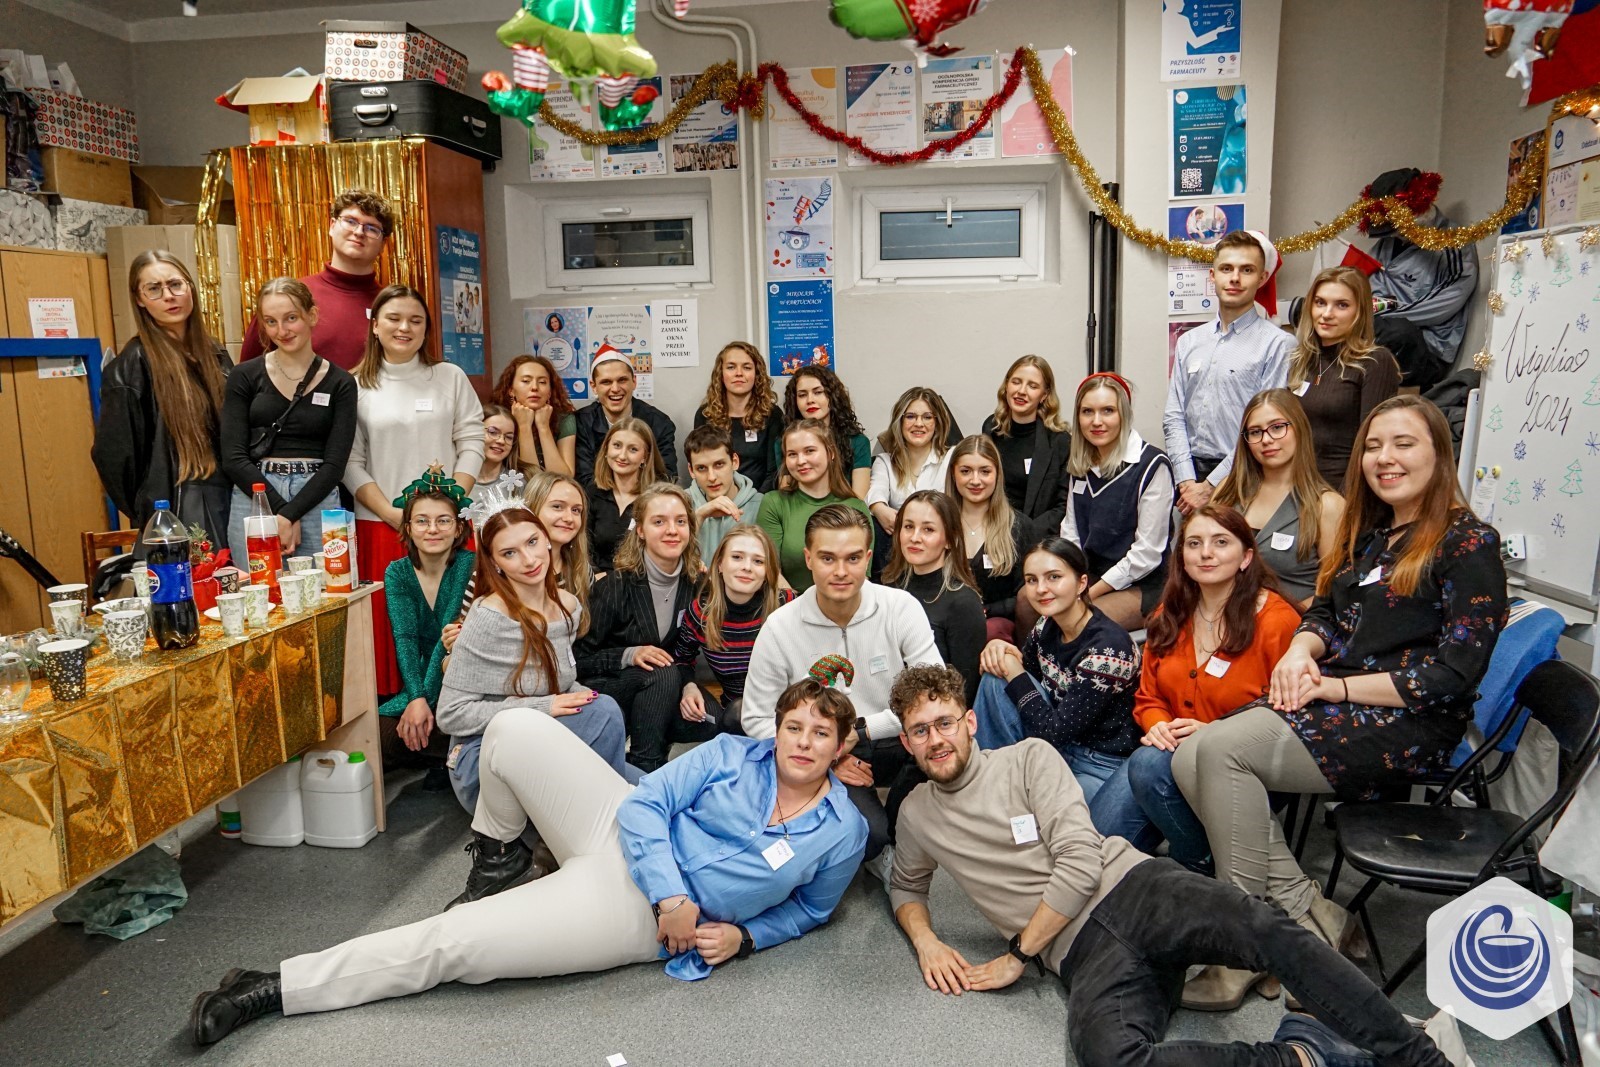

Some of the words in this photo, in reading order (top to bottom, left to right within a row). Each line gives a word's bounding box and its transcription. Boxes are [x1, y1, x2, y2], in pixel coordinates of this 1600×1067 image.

[1170, 58, 1206, 66] PRZYSZŁOŚĆ
[1501, 307, 1579, 406] Wigilia
[1519, 391, 1572, 436] 2024
[324, 542, 346, 556] Hortex
